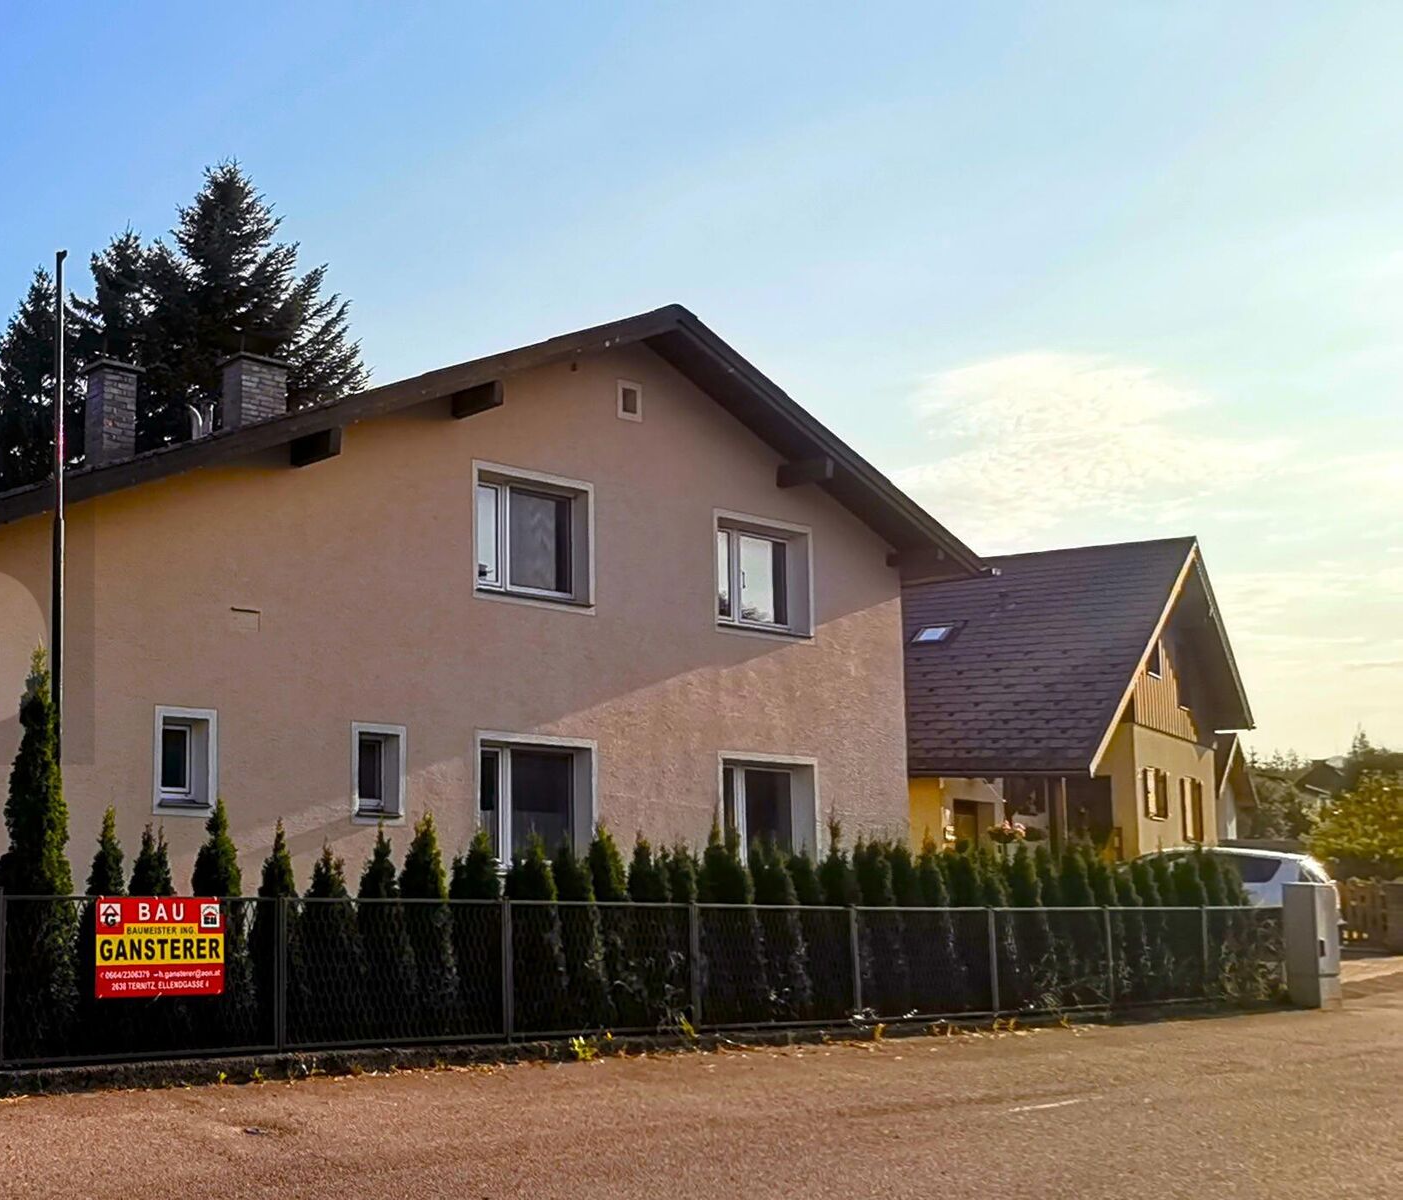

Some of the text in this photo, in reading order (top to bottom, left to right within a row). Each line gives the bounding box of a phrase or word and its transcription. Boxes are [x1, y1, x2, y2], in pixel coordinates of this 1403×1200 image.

[138, 903, 184, 921] BAU
[126, 926, 197, 935] BAUMEISTER ING.
[99, 938, 221, 961] GANSTERER
